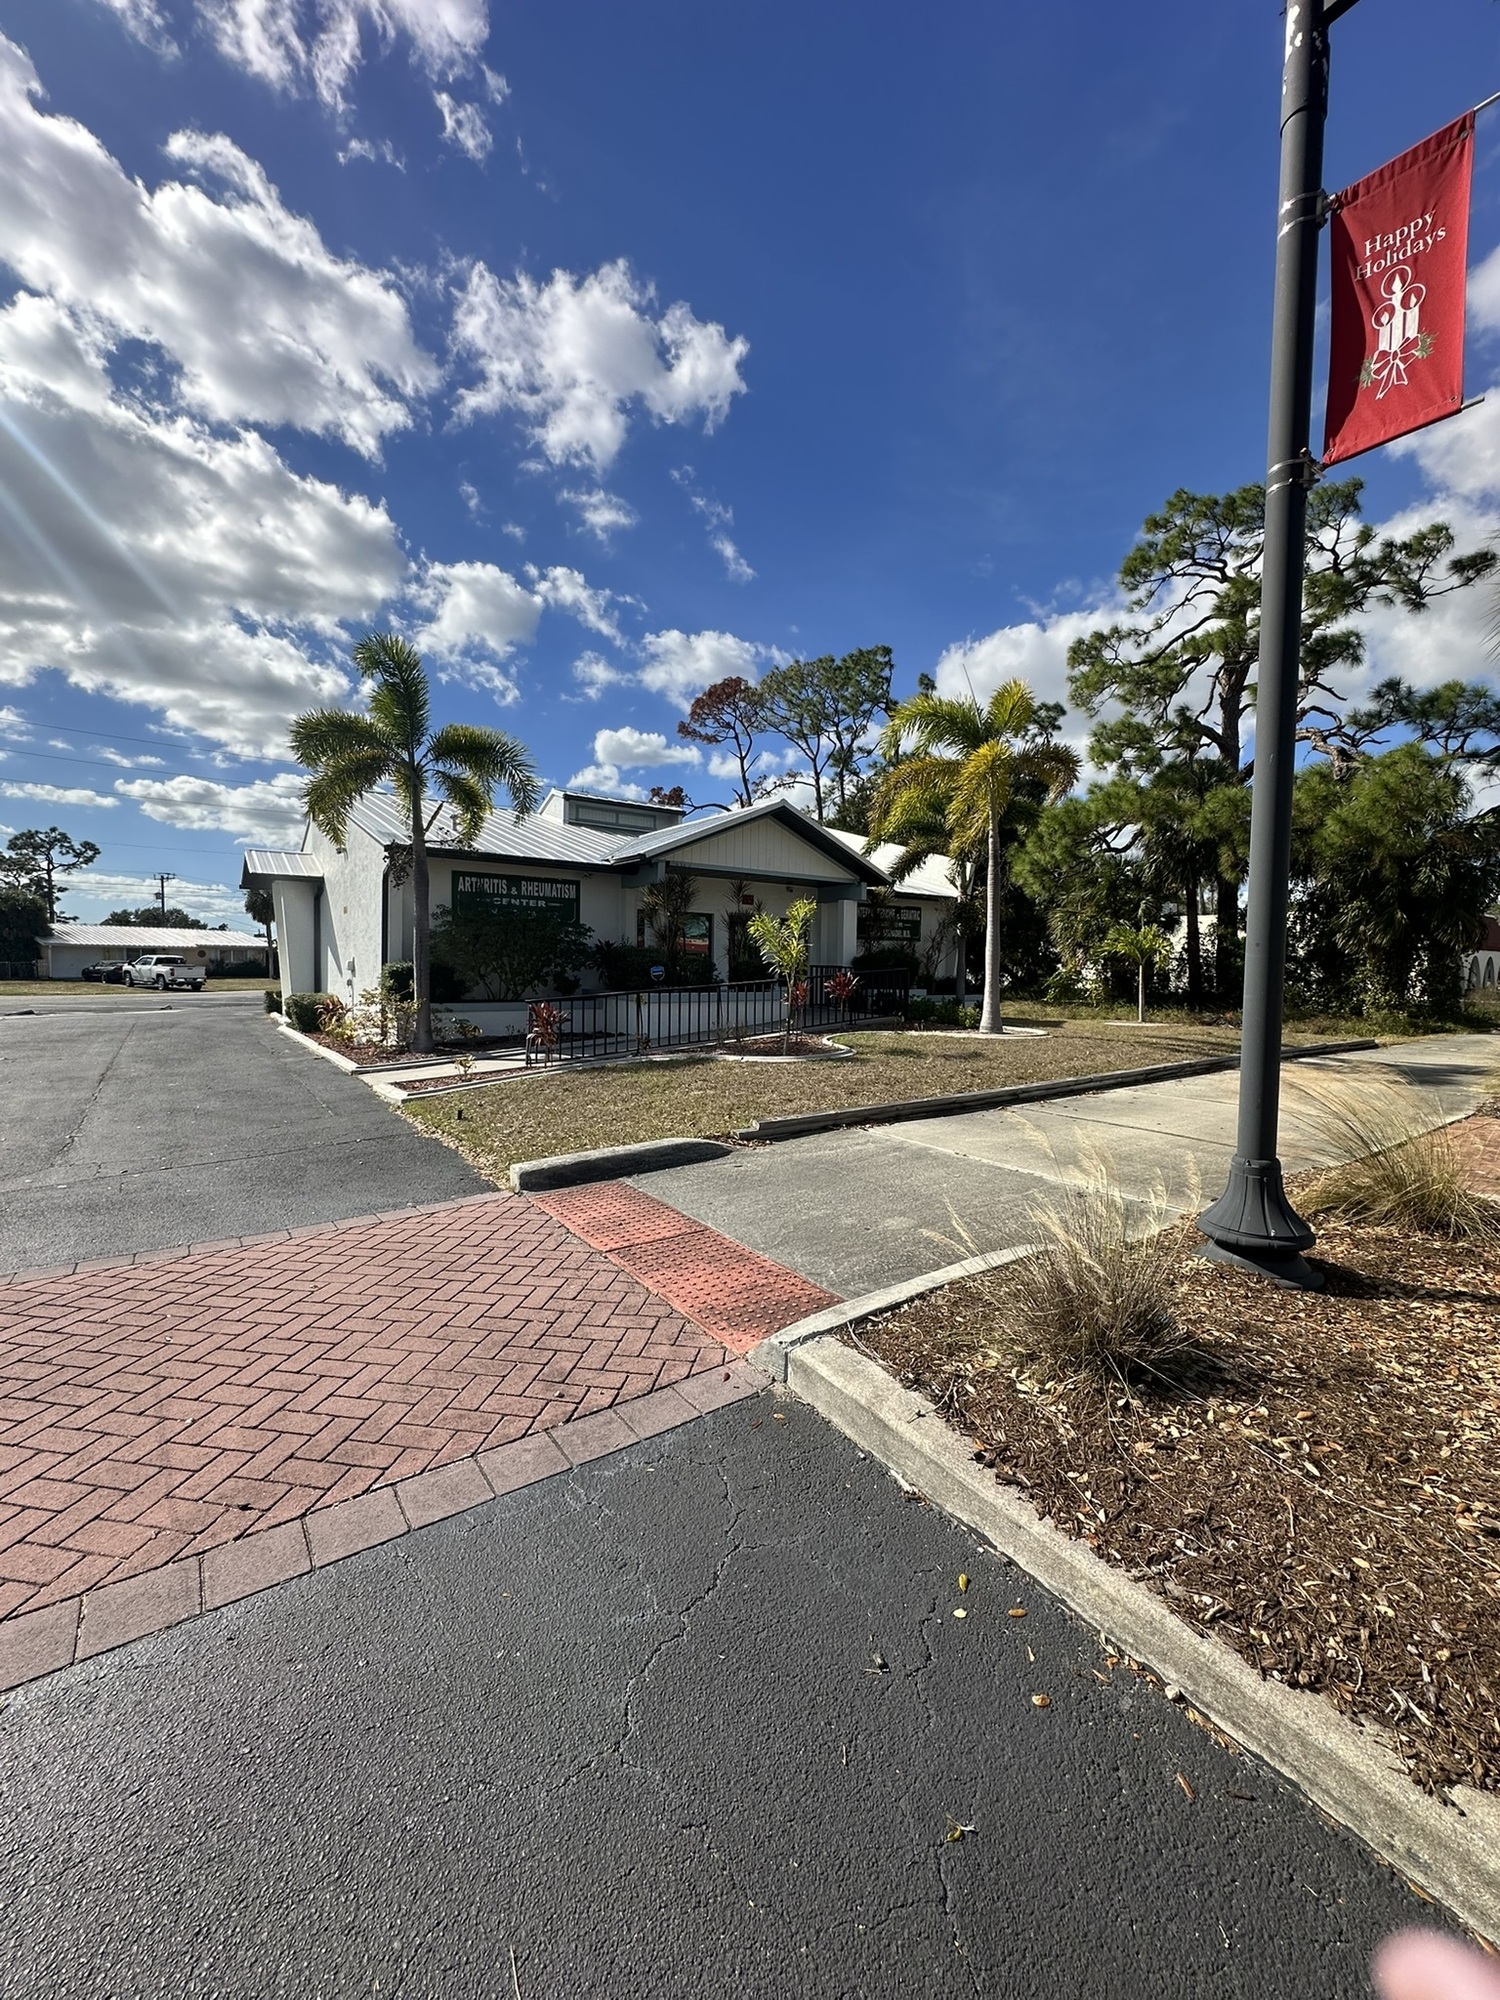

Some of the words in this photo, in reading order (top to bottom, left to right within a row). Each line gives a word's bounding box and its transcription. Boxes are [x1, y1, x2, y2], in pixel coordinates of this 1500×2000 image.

[1364, 210, 1435, 258] Happy
[1355, 227, 1446, 281] Holidays
[493, 897, 546, 908] CENTER
[511, 886, 518, 895] &
[521, 880, 576, 899] RHEUMATISM
